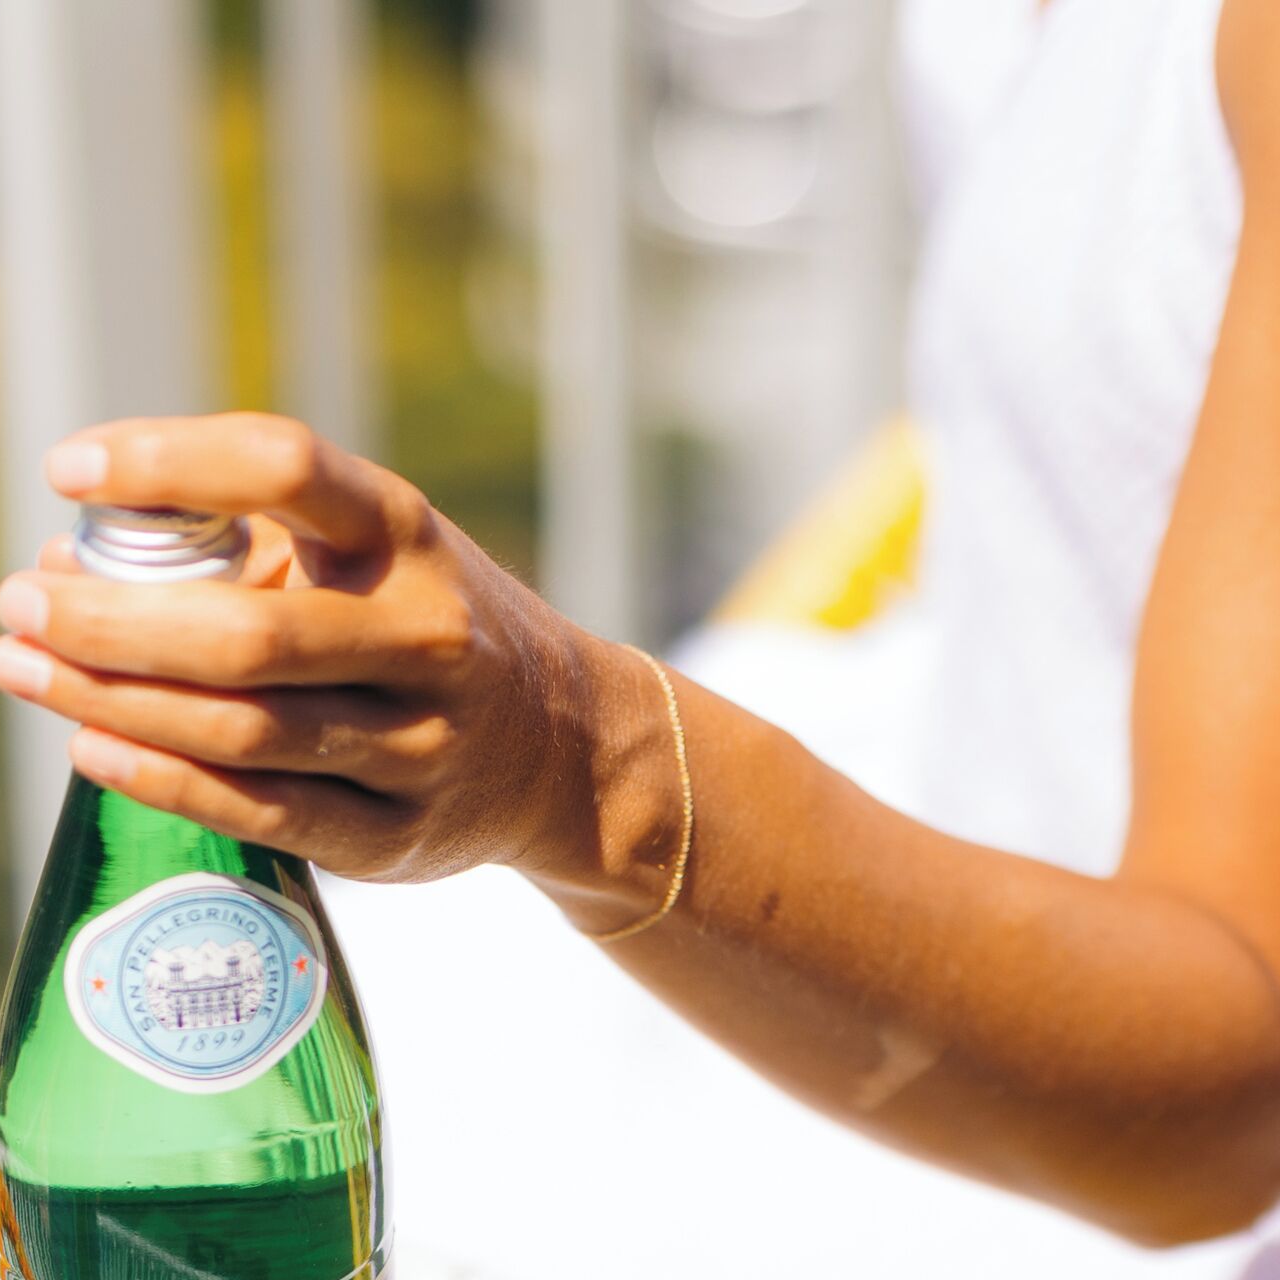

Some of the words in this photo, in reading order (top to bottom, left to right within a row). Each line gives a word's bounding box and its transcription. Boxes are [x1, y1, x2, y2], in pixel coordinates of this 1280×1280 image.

[127, 906, 260, 973] PELLEGRINO
[128, 984, 157, 1033] SAN
[175, 1028, 246, 1053] 1899
